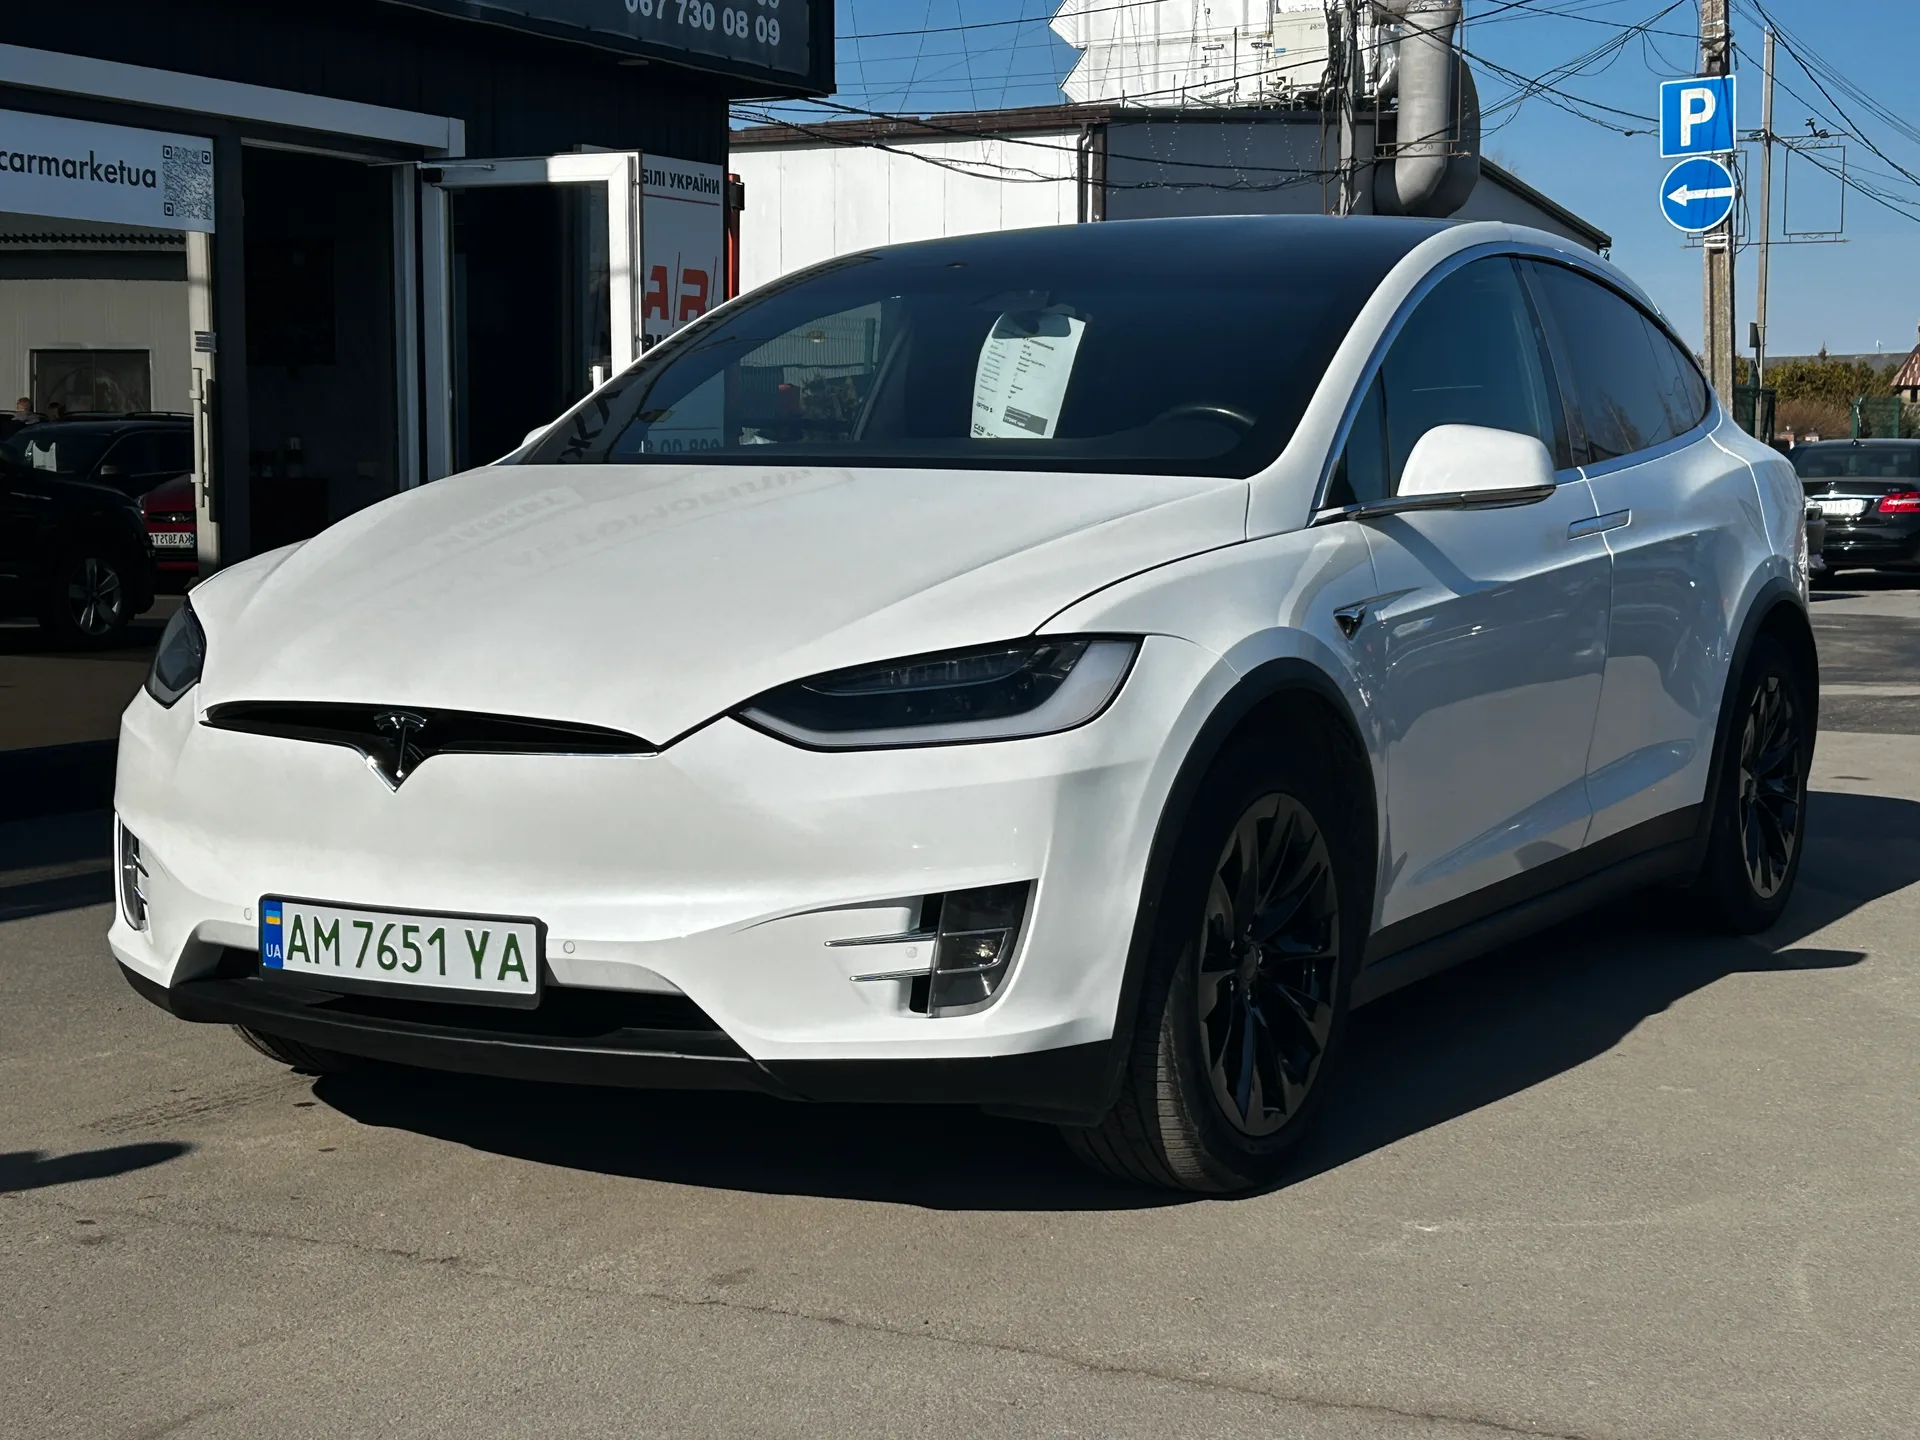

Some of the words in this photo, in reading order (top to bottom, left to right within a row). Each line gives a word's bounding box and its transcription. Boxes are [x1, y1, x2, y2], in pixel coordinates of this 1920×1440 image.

[675, 0, 715, 31] 730
[722, 7, 749, 39] 08
[755, 15, 780, 46] 09
[1680, 87, 1716, 147] P
[0, 150, 156, 189] carmarketua
[669, 172, 720, 195] УКРАЇНИ
[265, 942, 282, 959] UA
[286, 913, 341, 967] AM
[352, 920, 447, 976] 7651
[465, 928, 530, 983] YA
